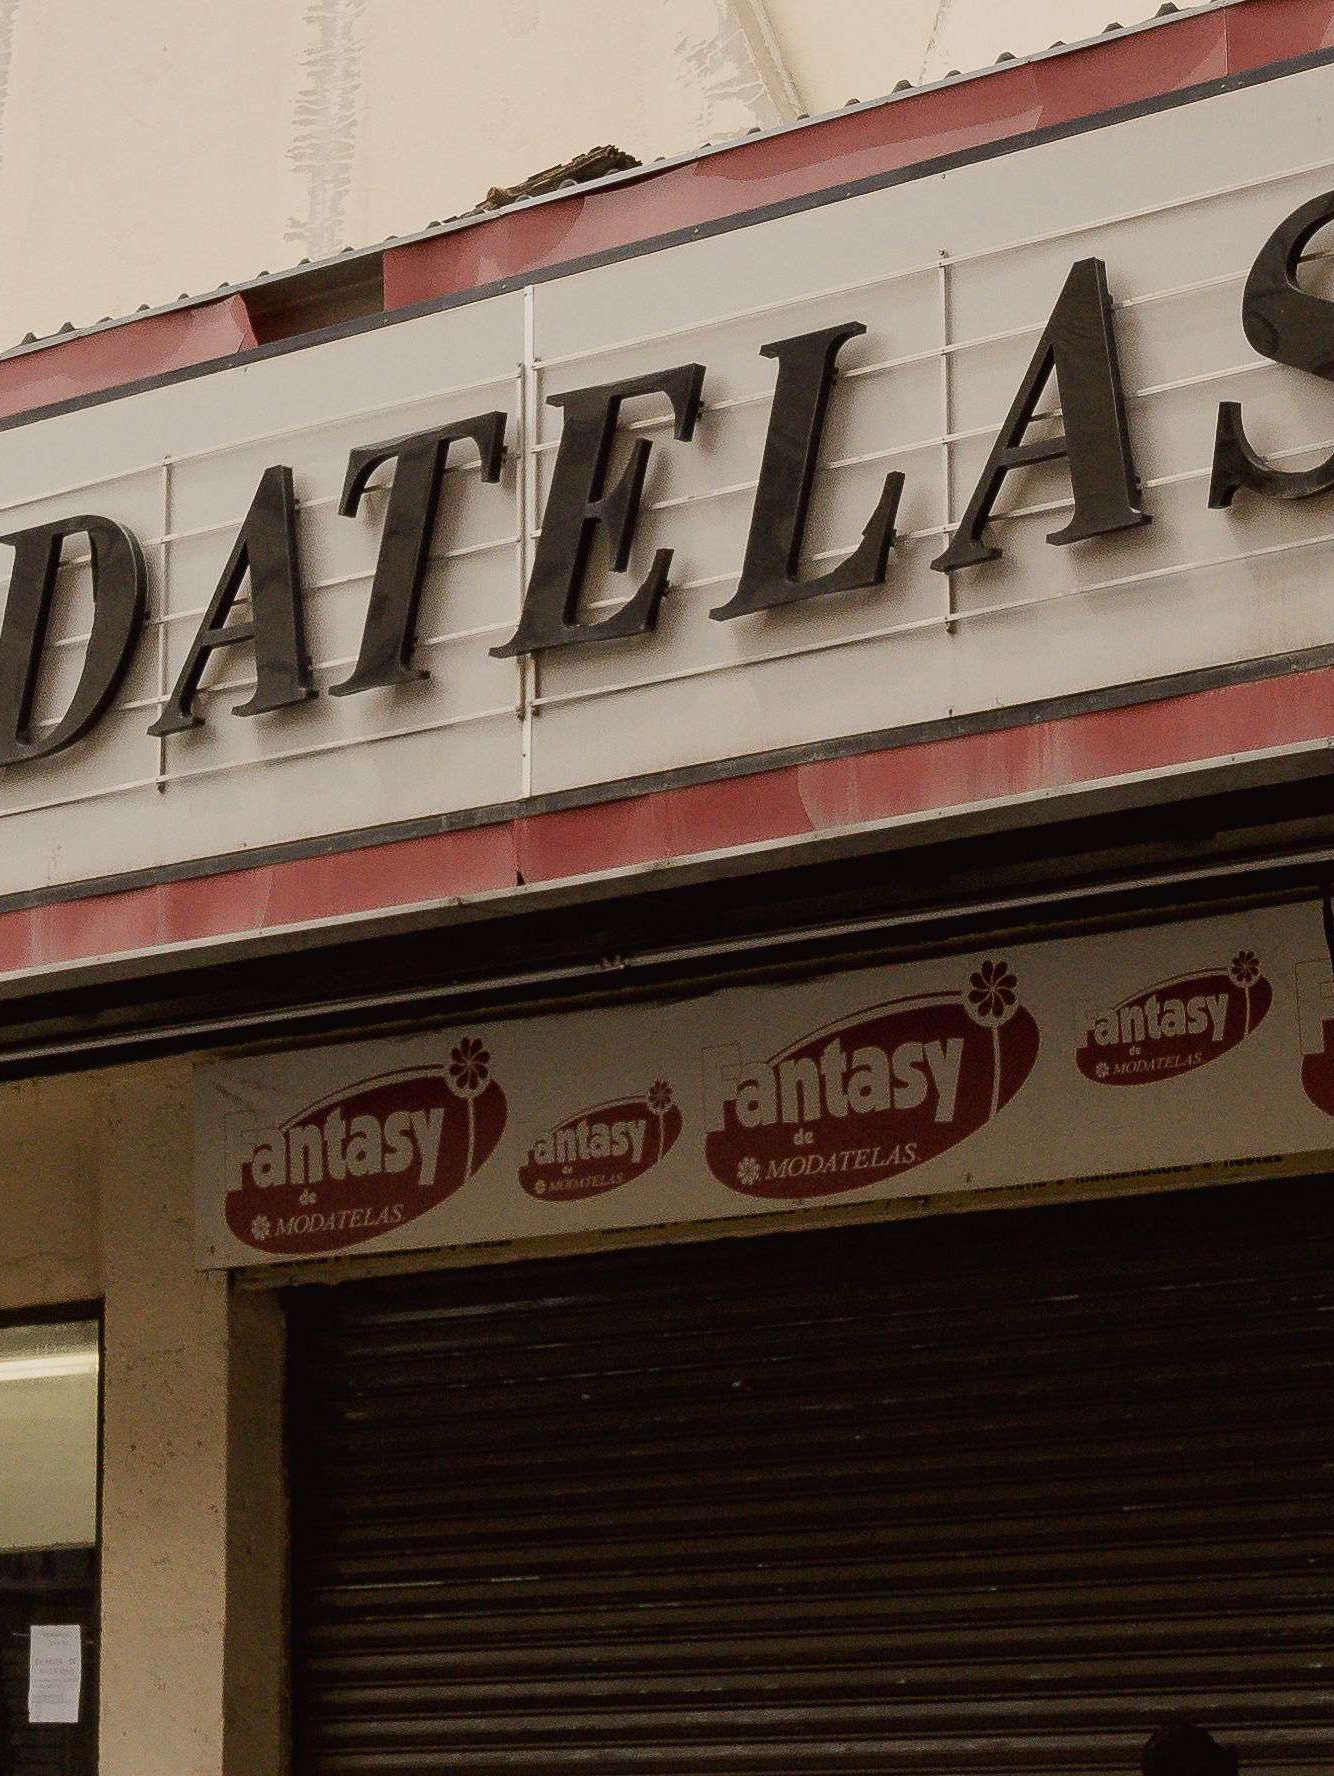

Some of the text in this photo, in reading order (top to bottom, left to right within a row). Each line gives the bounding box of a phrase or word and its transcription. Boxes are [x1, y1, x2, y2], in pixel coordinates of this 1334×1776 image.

[1113, 1051, 1203, 1075] MODATELAS
[793, 1128, 815, 1146] de
[767, 1142, 918, 1182] MODATELAS
[275, 1203, 405, 1237] MODATELAS
